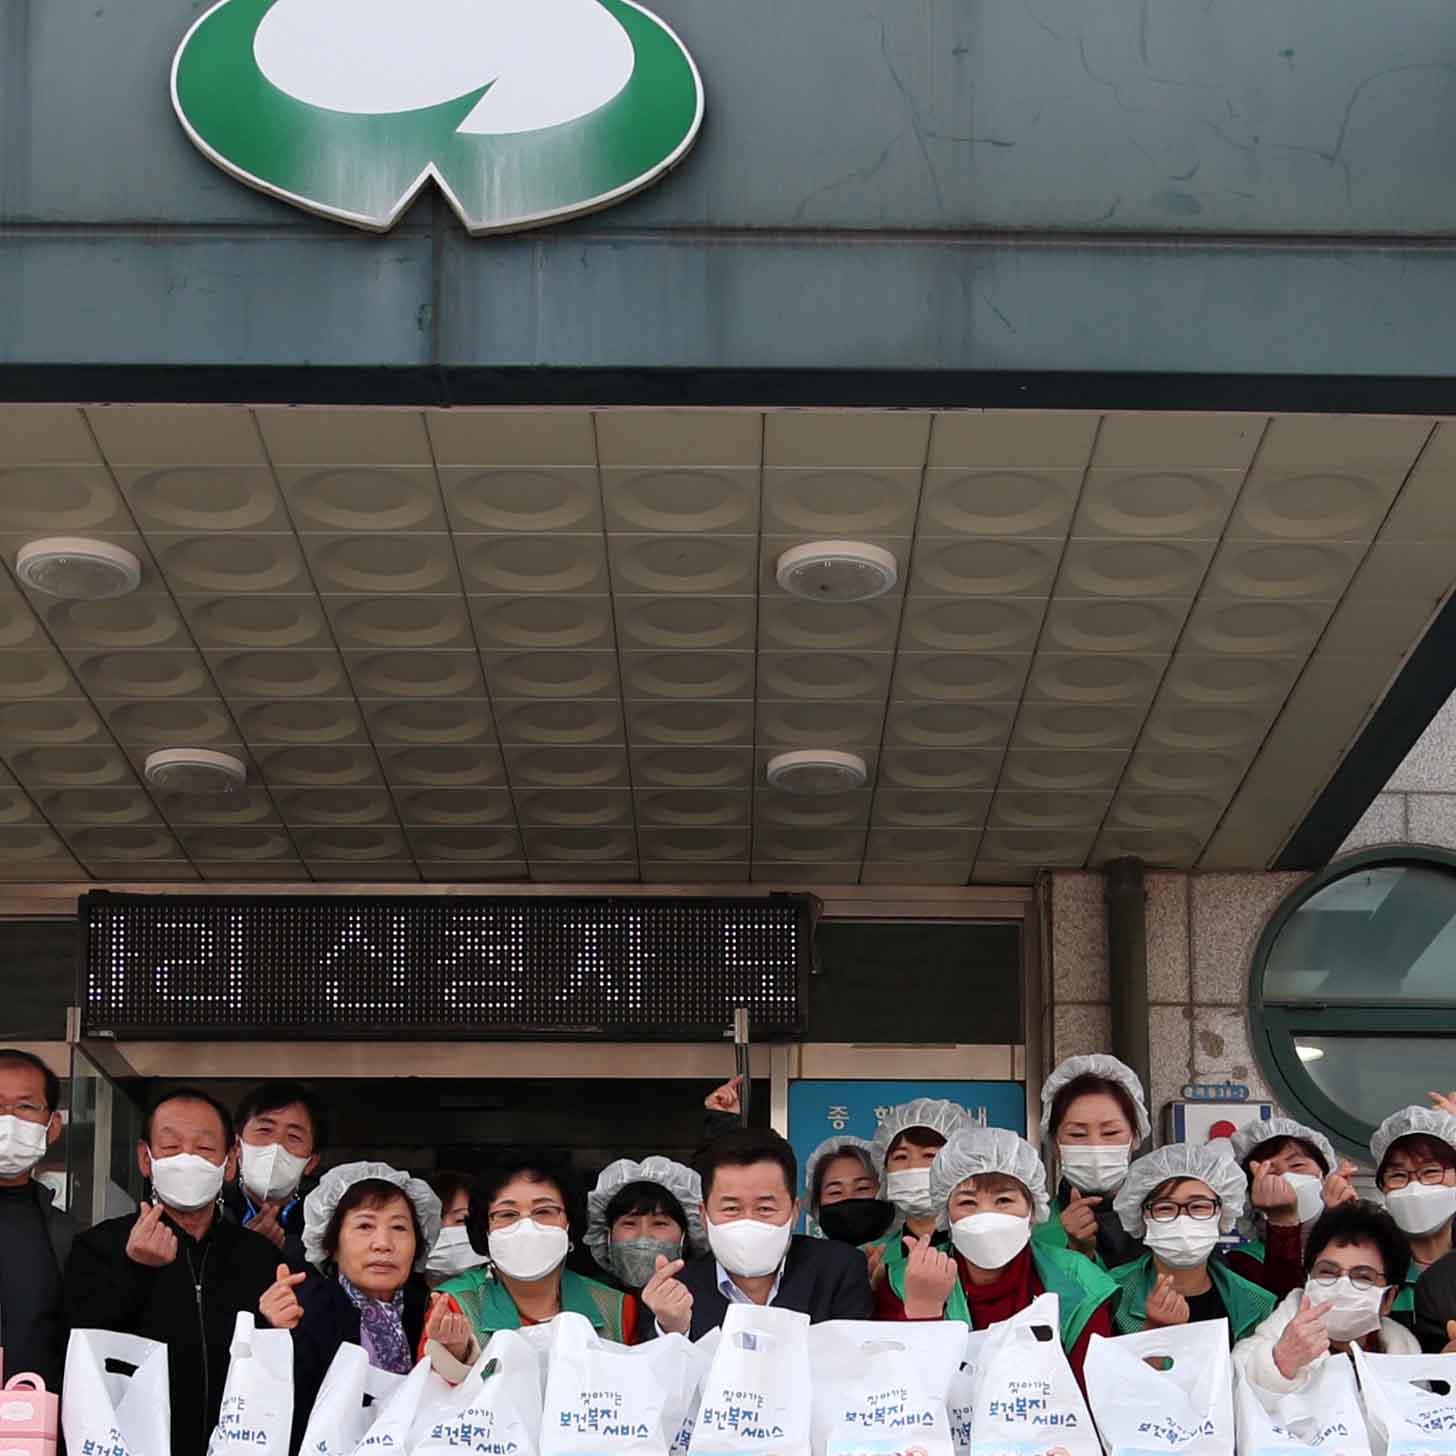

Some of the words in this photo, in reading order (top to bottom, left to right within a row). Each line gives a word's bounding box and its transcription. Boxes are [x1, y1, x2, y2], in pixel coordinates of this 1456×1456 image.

[319, 916, 656, 1007] 신청자
[866, 1388, 908, 1406] 찾아가는
[1008, 1381, 1051, 1396] 찾아가는
[580, 1392, 622, 1407] 찾아가는
[722, 1390, 765, 1408] 찾아가는
[704, 1406, 759, 1431] 보건복지
[845, 1404, 904, 1427] 보건복지
[989, 1397, 1046, 1422] 보건복지
[560, 1407, 617, 1433] 보건복지
[889, 1411, 934, 1428] 서비스
[1032, 1413, 1077, 1427] 서비스
[431, 1423, 490, 1447] 보건복지
[603, 1423, 648, 1438] 서비스
[740, 1425, 784, 1438] 서비스
[475, 1442, 518, 1455] 서비스
